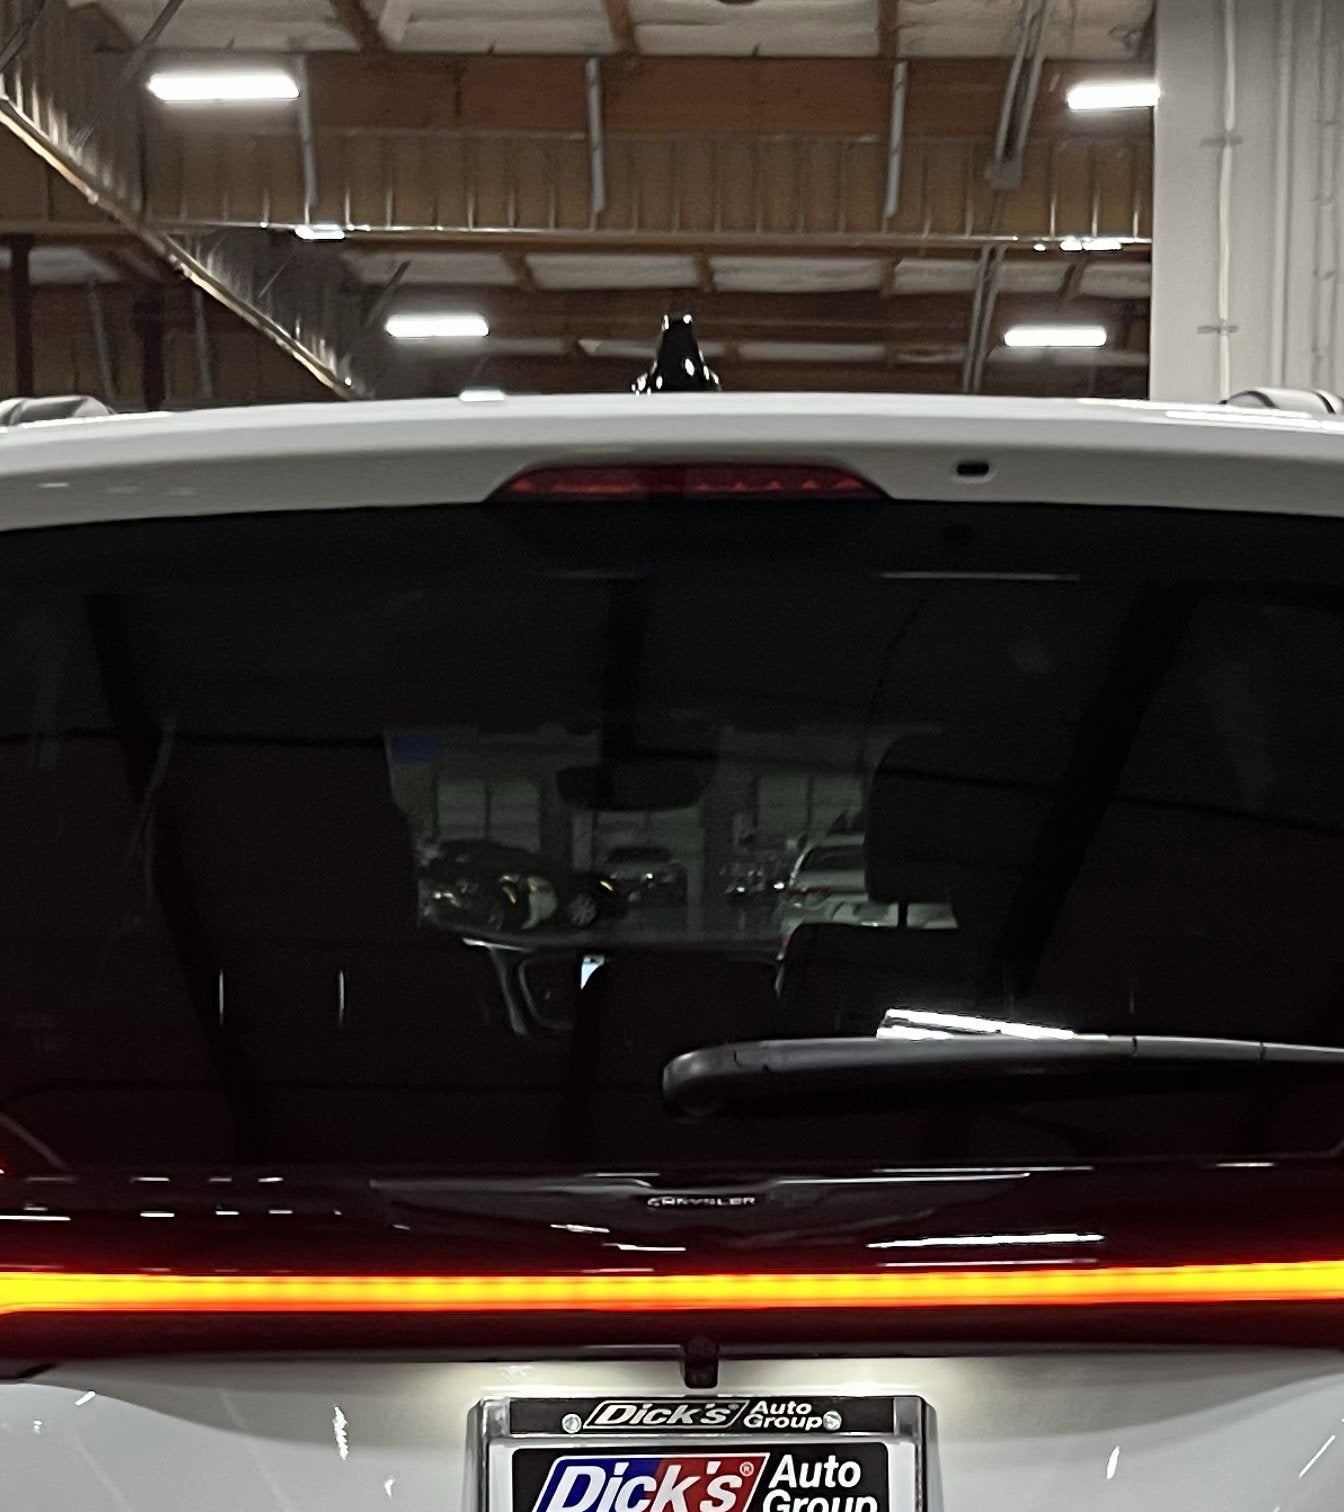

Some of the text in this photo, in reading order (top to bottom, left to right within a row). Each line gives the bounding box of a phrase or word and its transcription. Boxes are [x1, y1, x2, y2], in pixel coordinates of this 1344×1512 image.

[749, 1400, 813, 1416] Auto
[743, 1413, 824, 1431] Group
[768, 1454, 862, 1489] Auto
